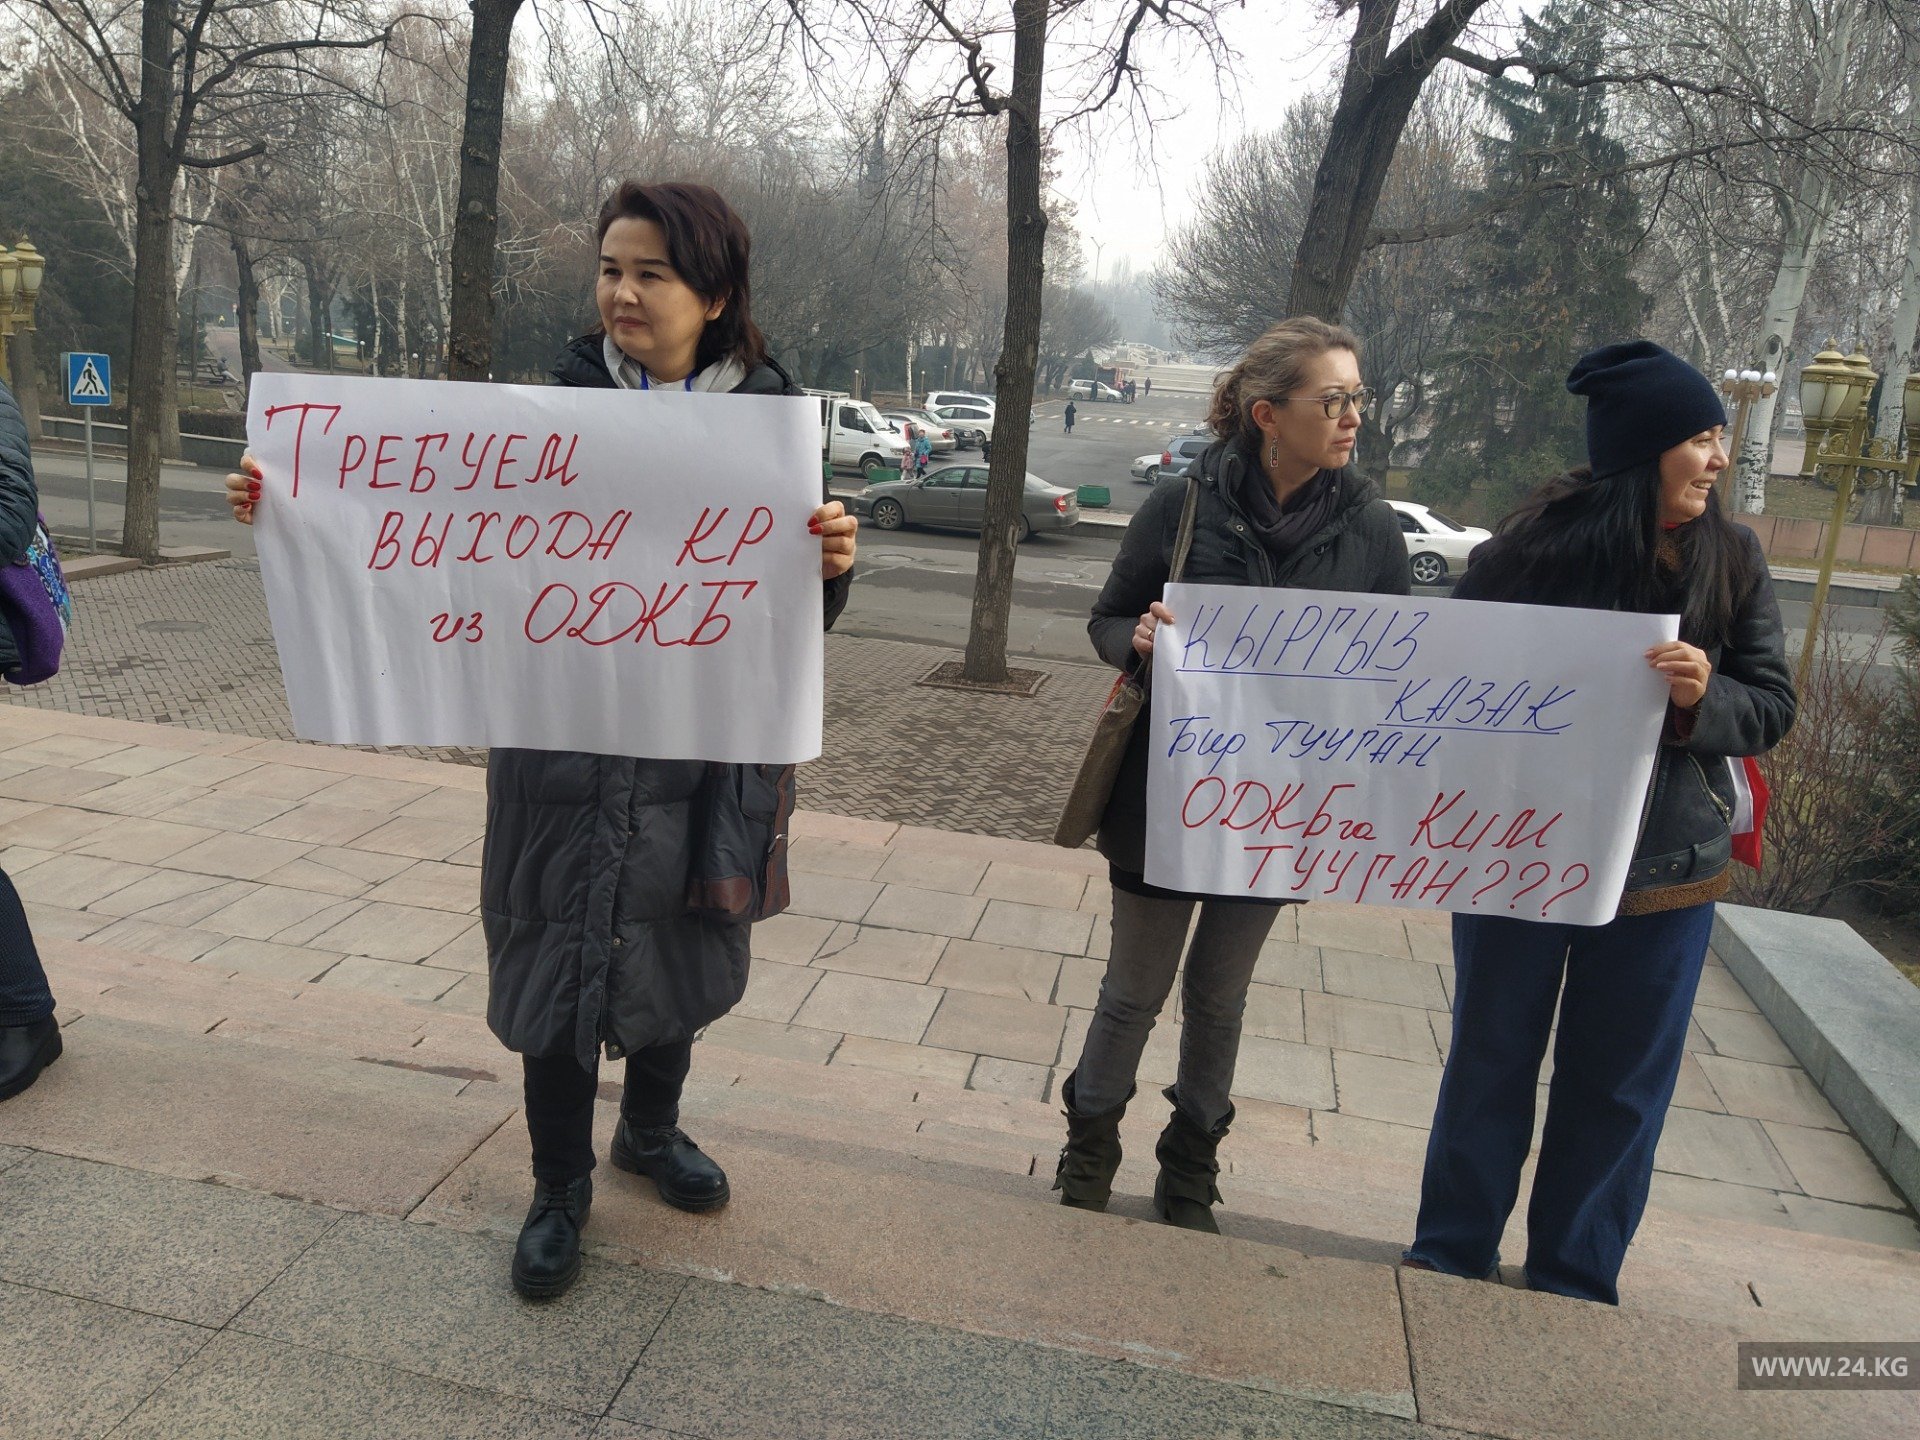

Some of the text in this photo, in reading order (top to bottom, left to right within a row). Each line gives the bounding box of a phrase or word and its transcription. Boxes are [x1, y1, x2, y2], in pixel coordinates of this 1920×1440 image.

[368, 506, 775, 571] ВЫХОДА КР
[429, 580, 758, 647] из ОДКБ
[1182, 604, 1430, 675] КЫРГЫЗ
[1384, 676, 1576, 731] КАЗАК
